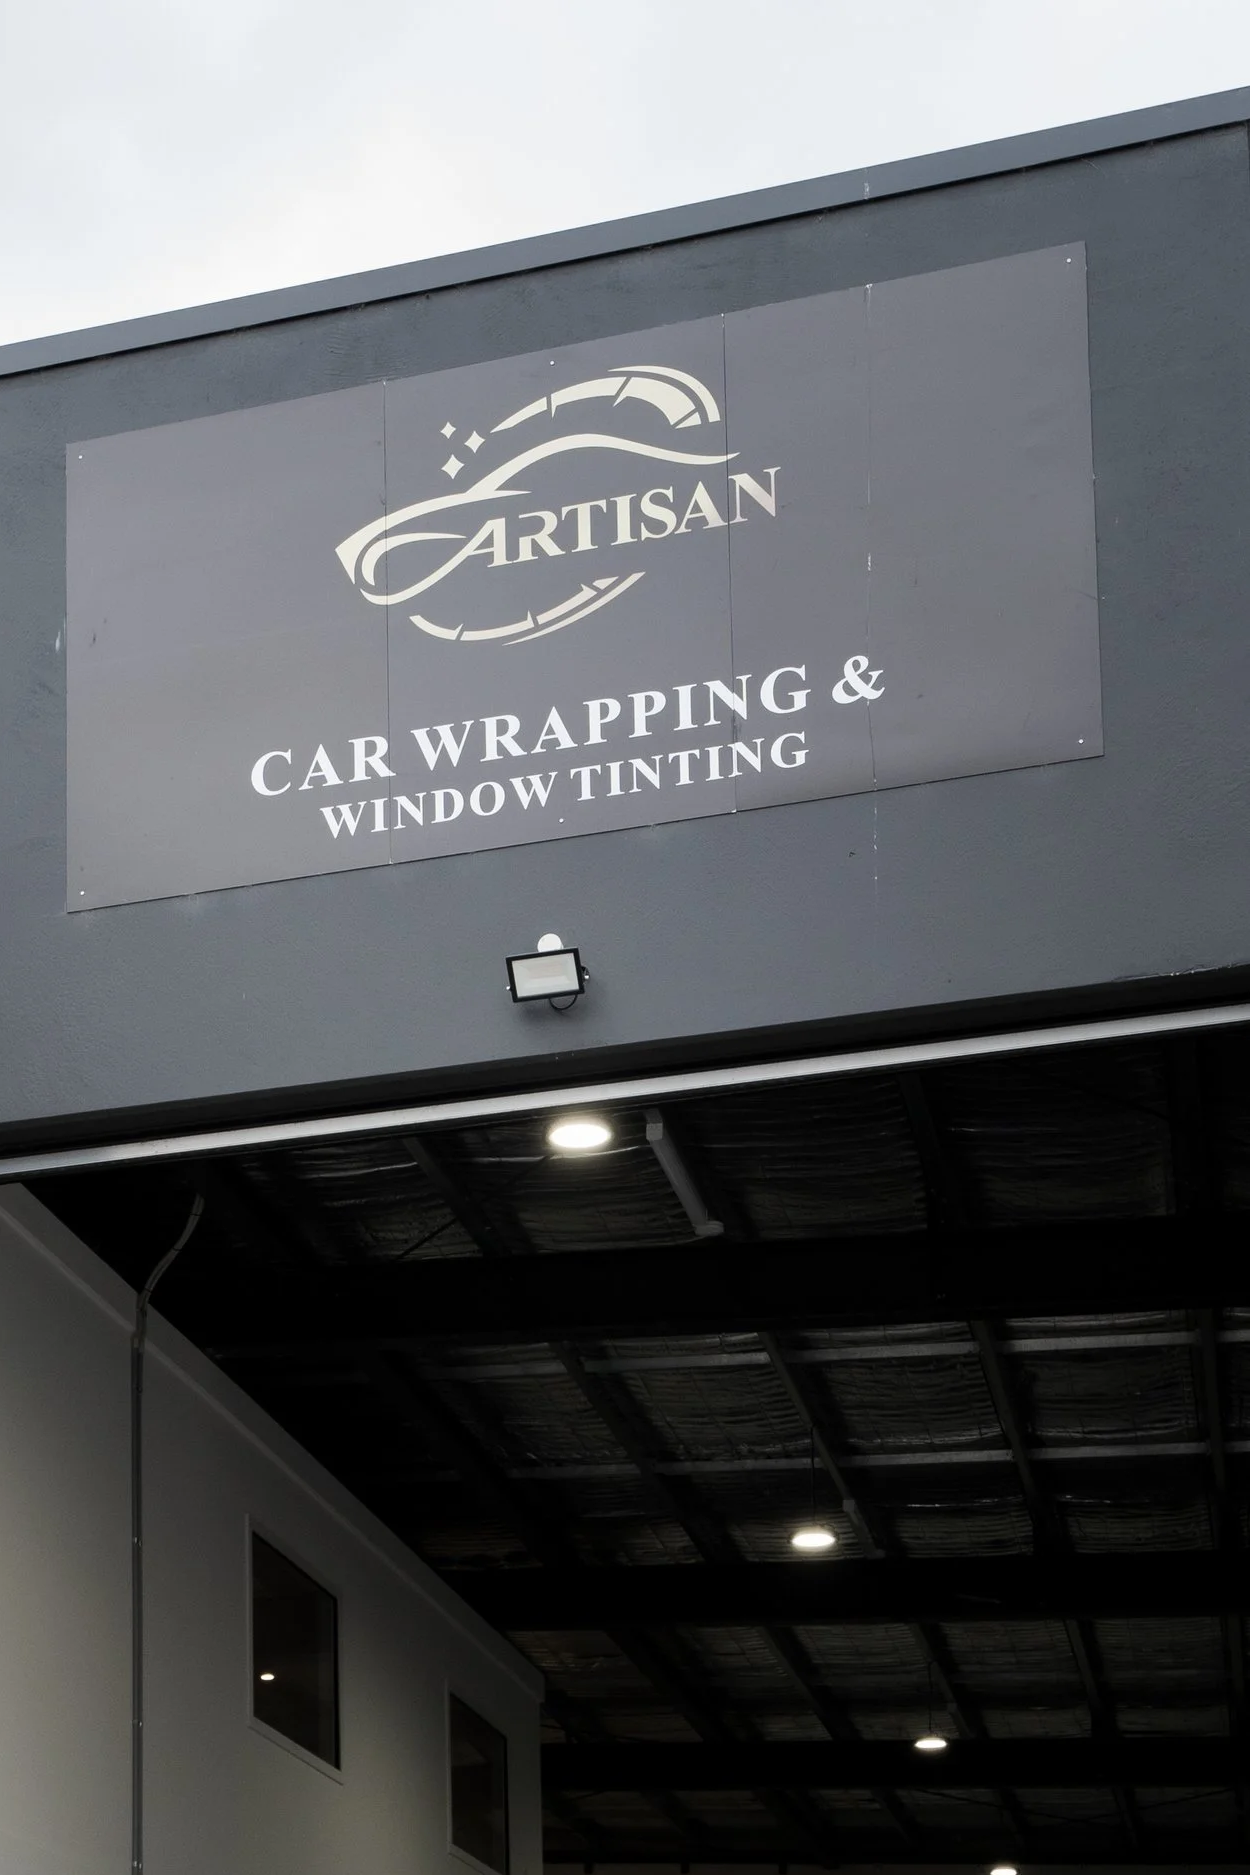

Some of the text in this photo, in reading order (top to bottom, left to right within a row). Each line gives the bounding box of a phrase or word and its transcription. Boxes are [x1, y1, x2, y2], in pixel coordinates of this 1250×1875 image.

[464, 466, 782, 569] ARTISAN
[250, 655, 886, 797] CAR WRAPPING &
[319, 730, 810, 839] WINDOW TINTING
